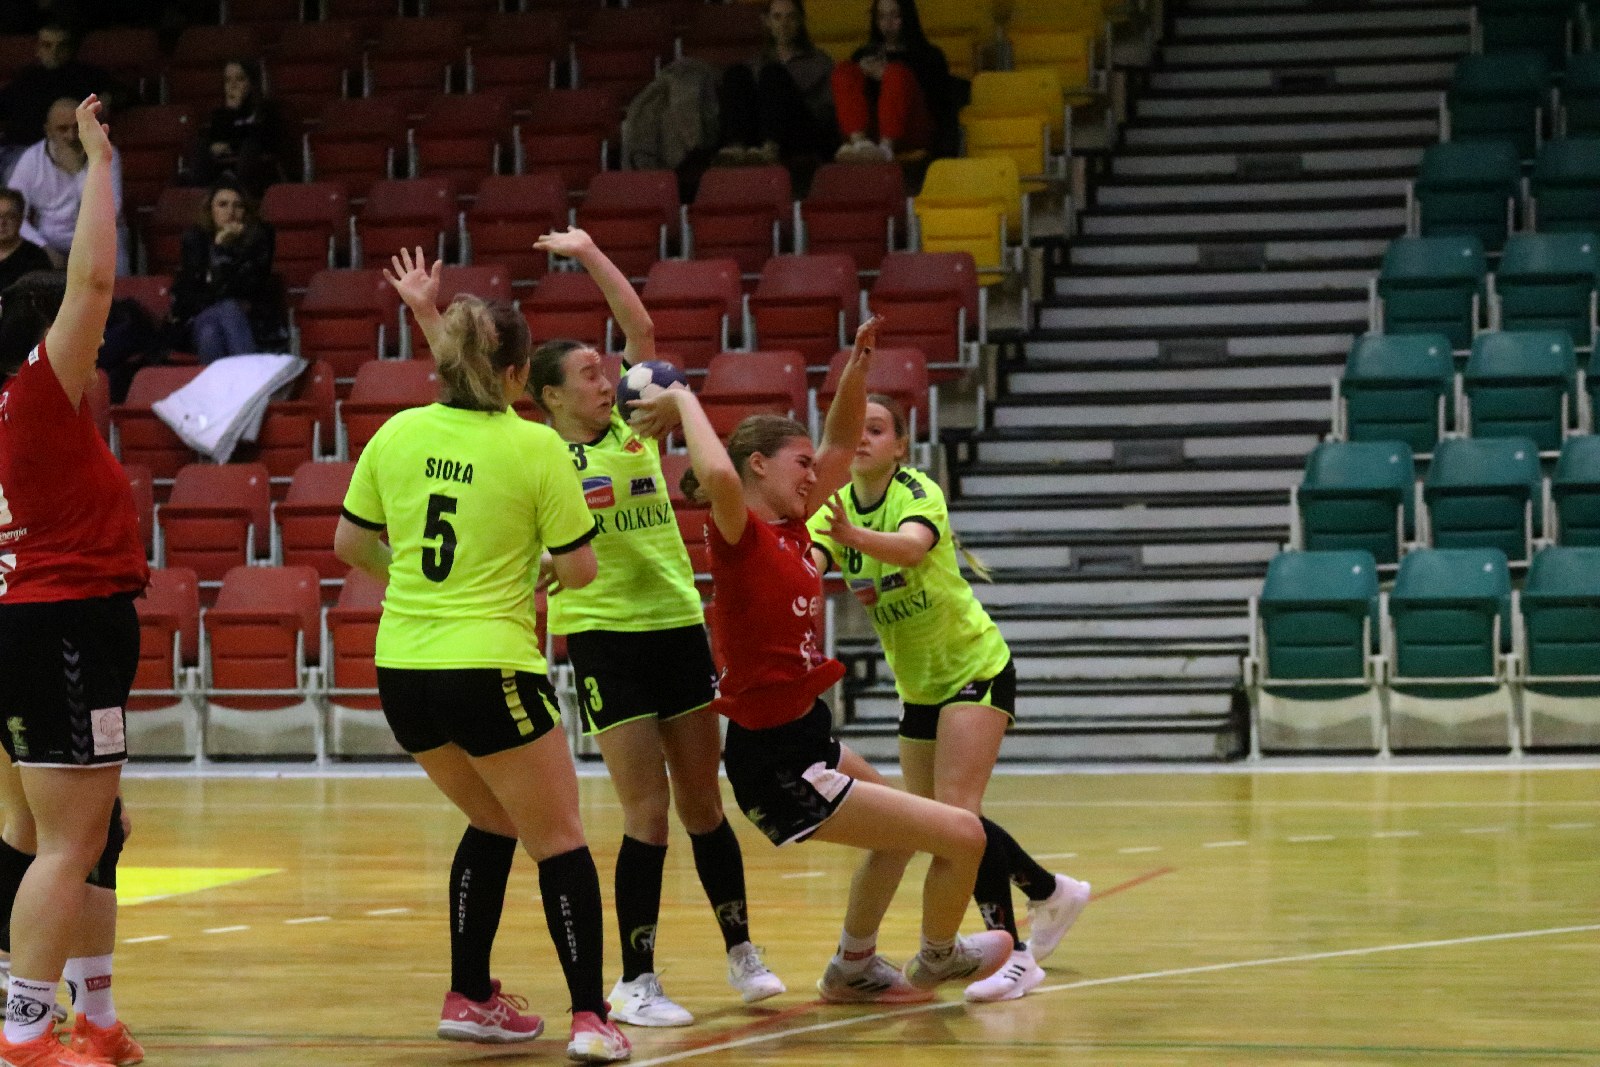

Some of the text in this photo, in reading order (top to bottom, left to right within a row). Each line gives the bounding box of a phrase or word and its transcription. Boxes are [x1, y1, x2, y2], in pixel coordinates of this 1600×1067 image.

[425, 458, 473, 485] SIOŁA
[615, 503, 670, 532] OLKUSZ
[421, 493, 457, 583] 5
[584, 676, 603, 712] 3
